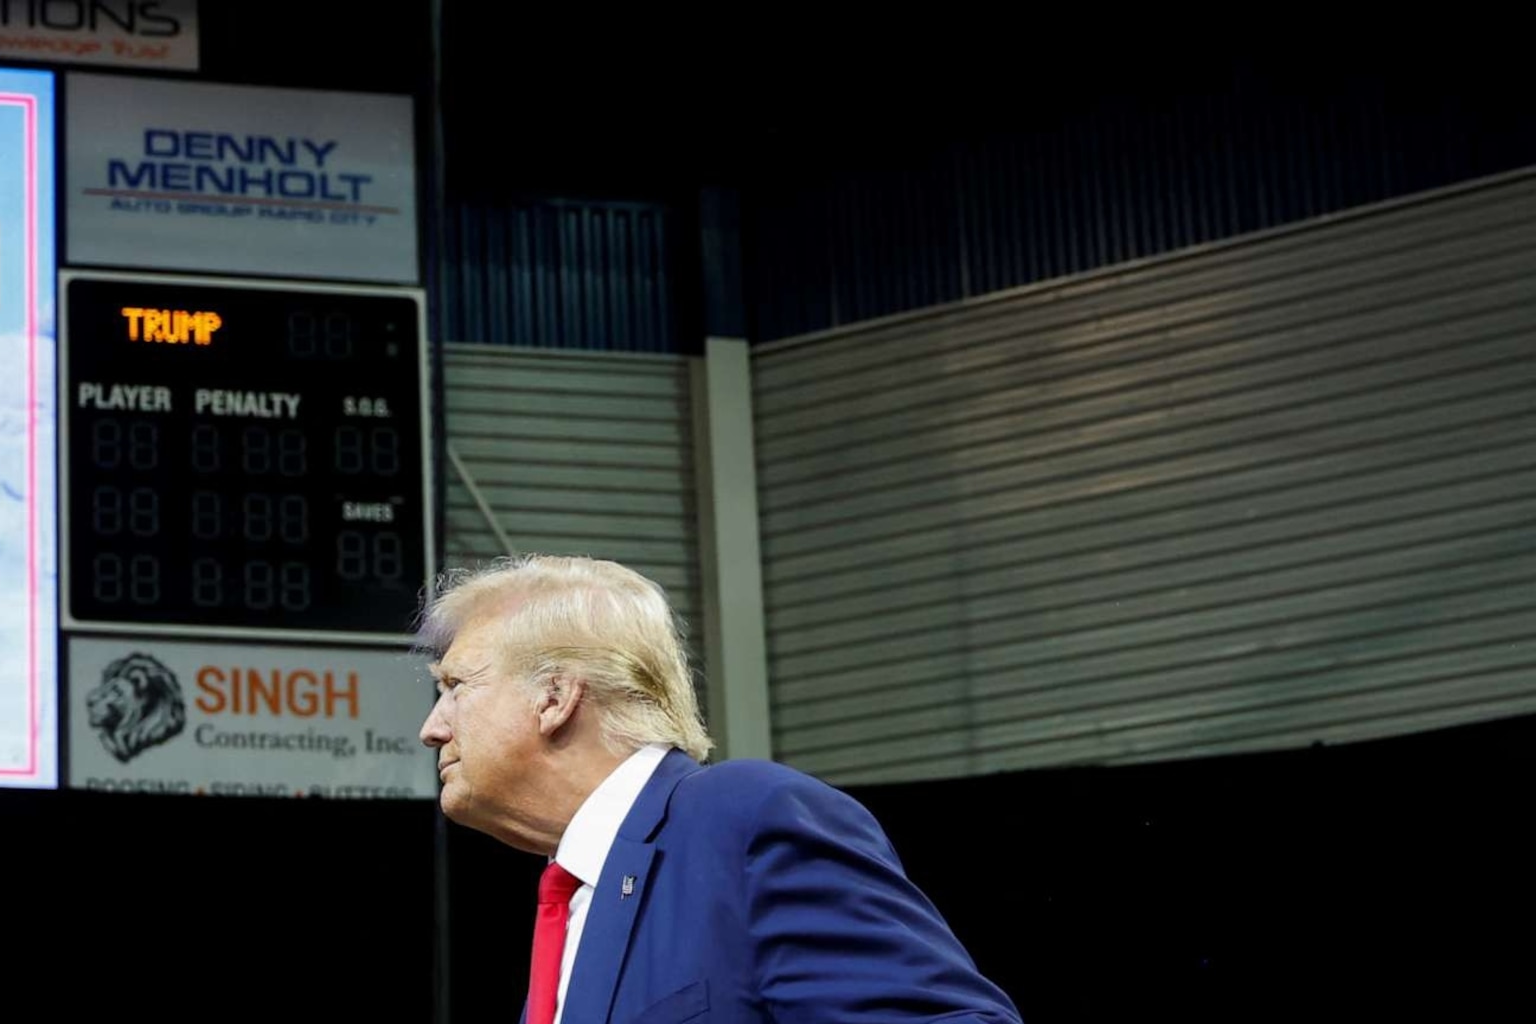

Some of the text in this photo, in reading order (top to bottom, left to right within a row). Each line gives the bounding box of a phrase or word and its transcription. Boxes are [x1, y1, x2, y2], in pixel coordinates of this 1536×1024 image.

[144, 129, 337, 167] DENNY
[108, 161, 372, 202] MENHOLT
[110, 199, 171, 213] AUTO
[178, 203, 252, 217] GROUP
[330, 212, 378, 226] CITY
[121, 307, 222, 345] TRUMP
[78, 382, 172, 412] PLAYER
[195, 388, 300, 418] PENALTY
[342, 502, 394, 522] SAVES
[195, 664, 361, 719] SINGH
[195, 723, 415, 758] Contracting, Inc.
